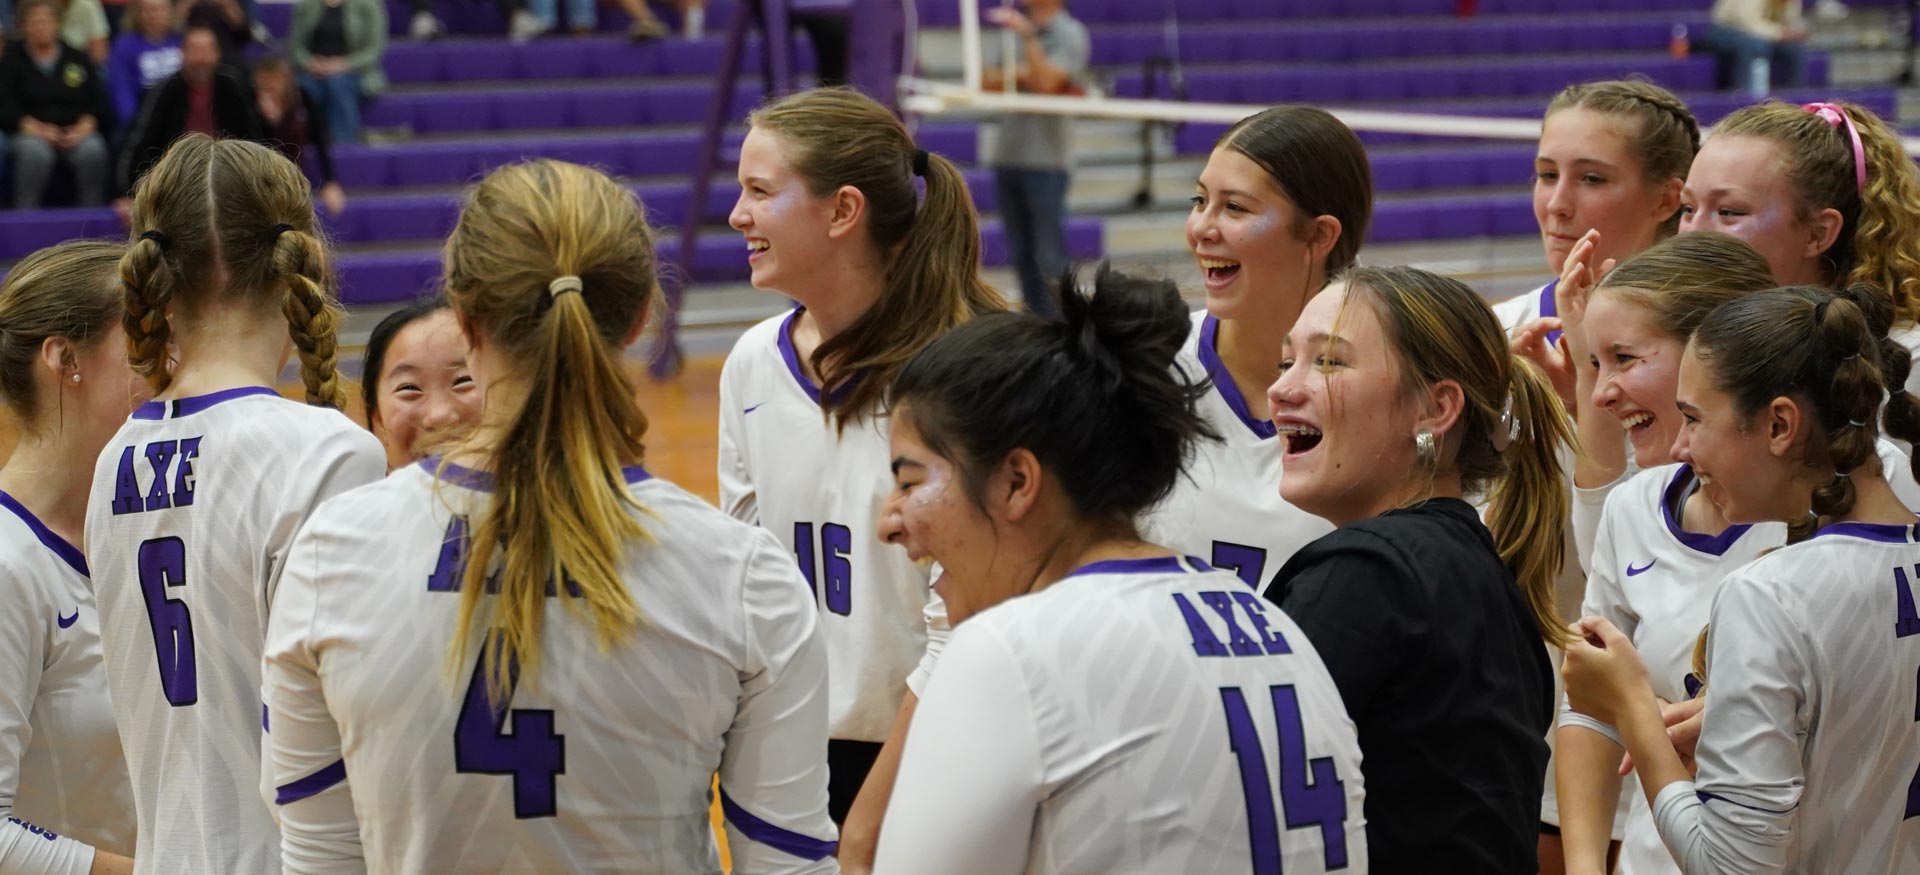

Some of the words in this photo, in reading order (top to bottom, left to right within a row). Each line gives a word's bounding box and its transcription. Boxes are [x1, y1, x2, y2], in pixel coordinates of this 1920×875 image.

[112, 435, 203, 515] AXE
[138, 536, 198, 707] 6
[794, 522, 852, 617] 16
[1171, 591, 1293, 657] AXE
[454, 627, 565, 818] 4
[1219, 684, 1348, 875] 14
